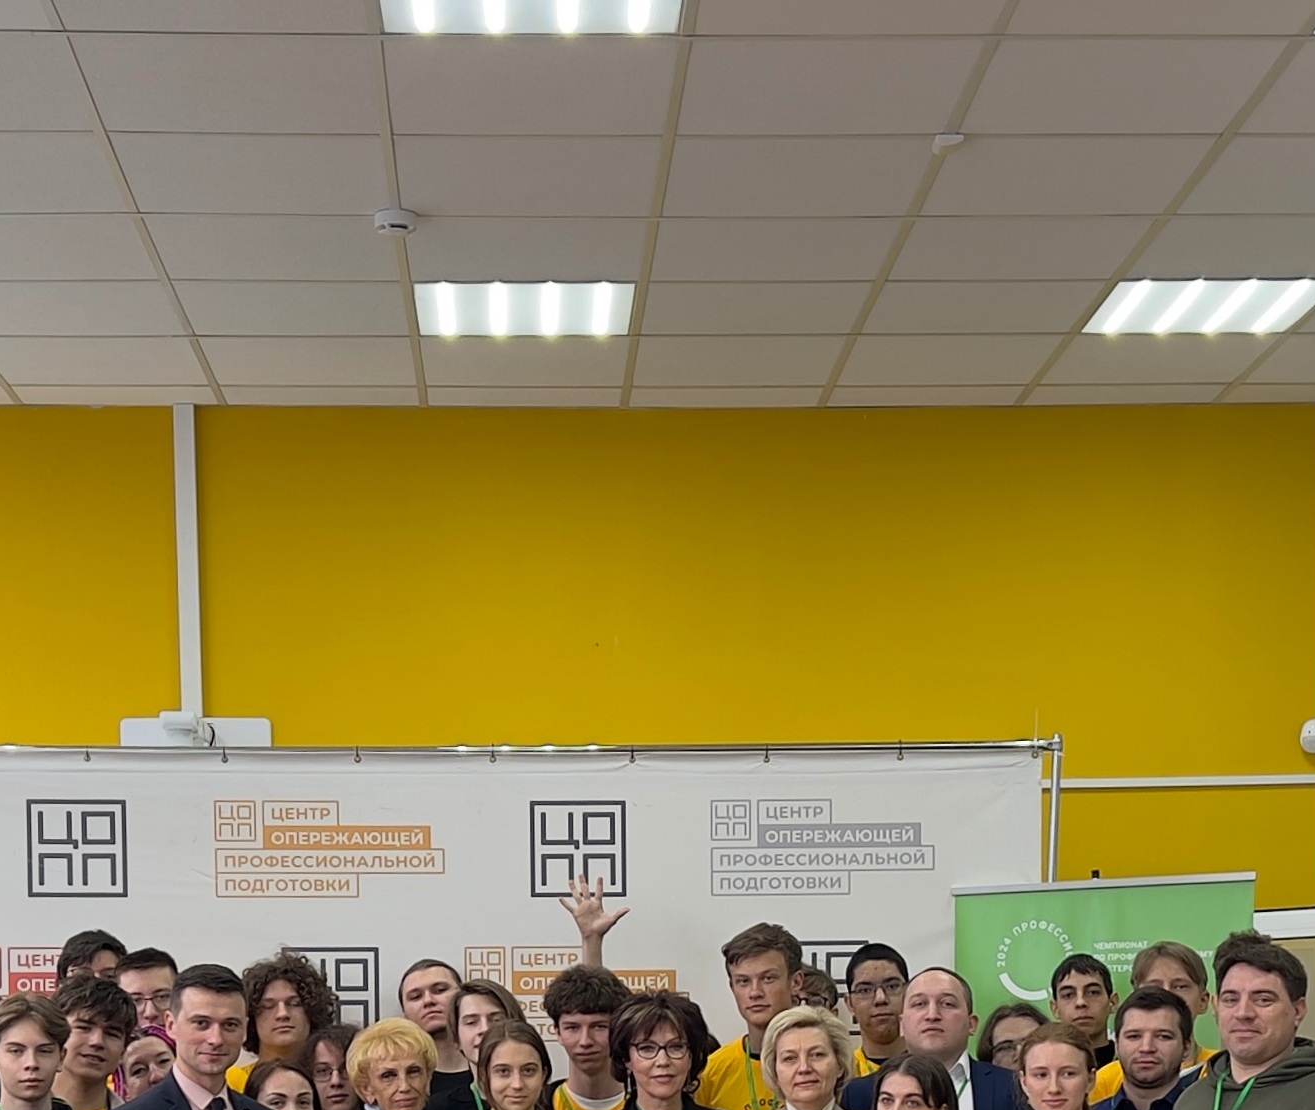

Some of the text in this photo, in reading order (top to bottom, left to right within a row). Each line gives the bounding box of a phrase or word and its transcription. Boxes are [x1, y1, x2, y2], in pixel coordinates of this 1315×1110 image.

[271, 806, 331, 822] ЦЕНТР
[765, 805, 824, 821] ЦЕНТР
[270, 829, 424, 847] ОПЕРЕЖАЮЩЕЙ
[764, 826, 915, 845] ОПЕРЕЖАЮЩЕЙ
[224, 852, 436, 869] ПРОФЕССИОНАЛЬНОЙ
[719, 849, 926, 867] ПРОФЕССИОНАЛЬНОЙ
[224, 879, 351, 893] ПОДГОТОВКИ
[719, 876, 842, 892] ПОДГОТОВКИ
[996, 920, 1074, 968] 2024 ПРОФЕССИ
[1093, 940, 1148, 950] ЧЕМПИОНАТ
[17, 954, 59, 969] ЦЕН
[520, 953, 578, 967] ЦЕНТР
